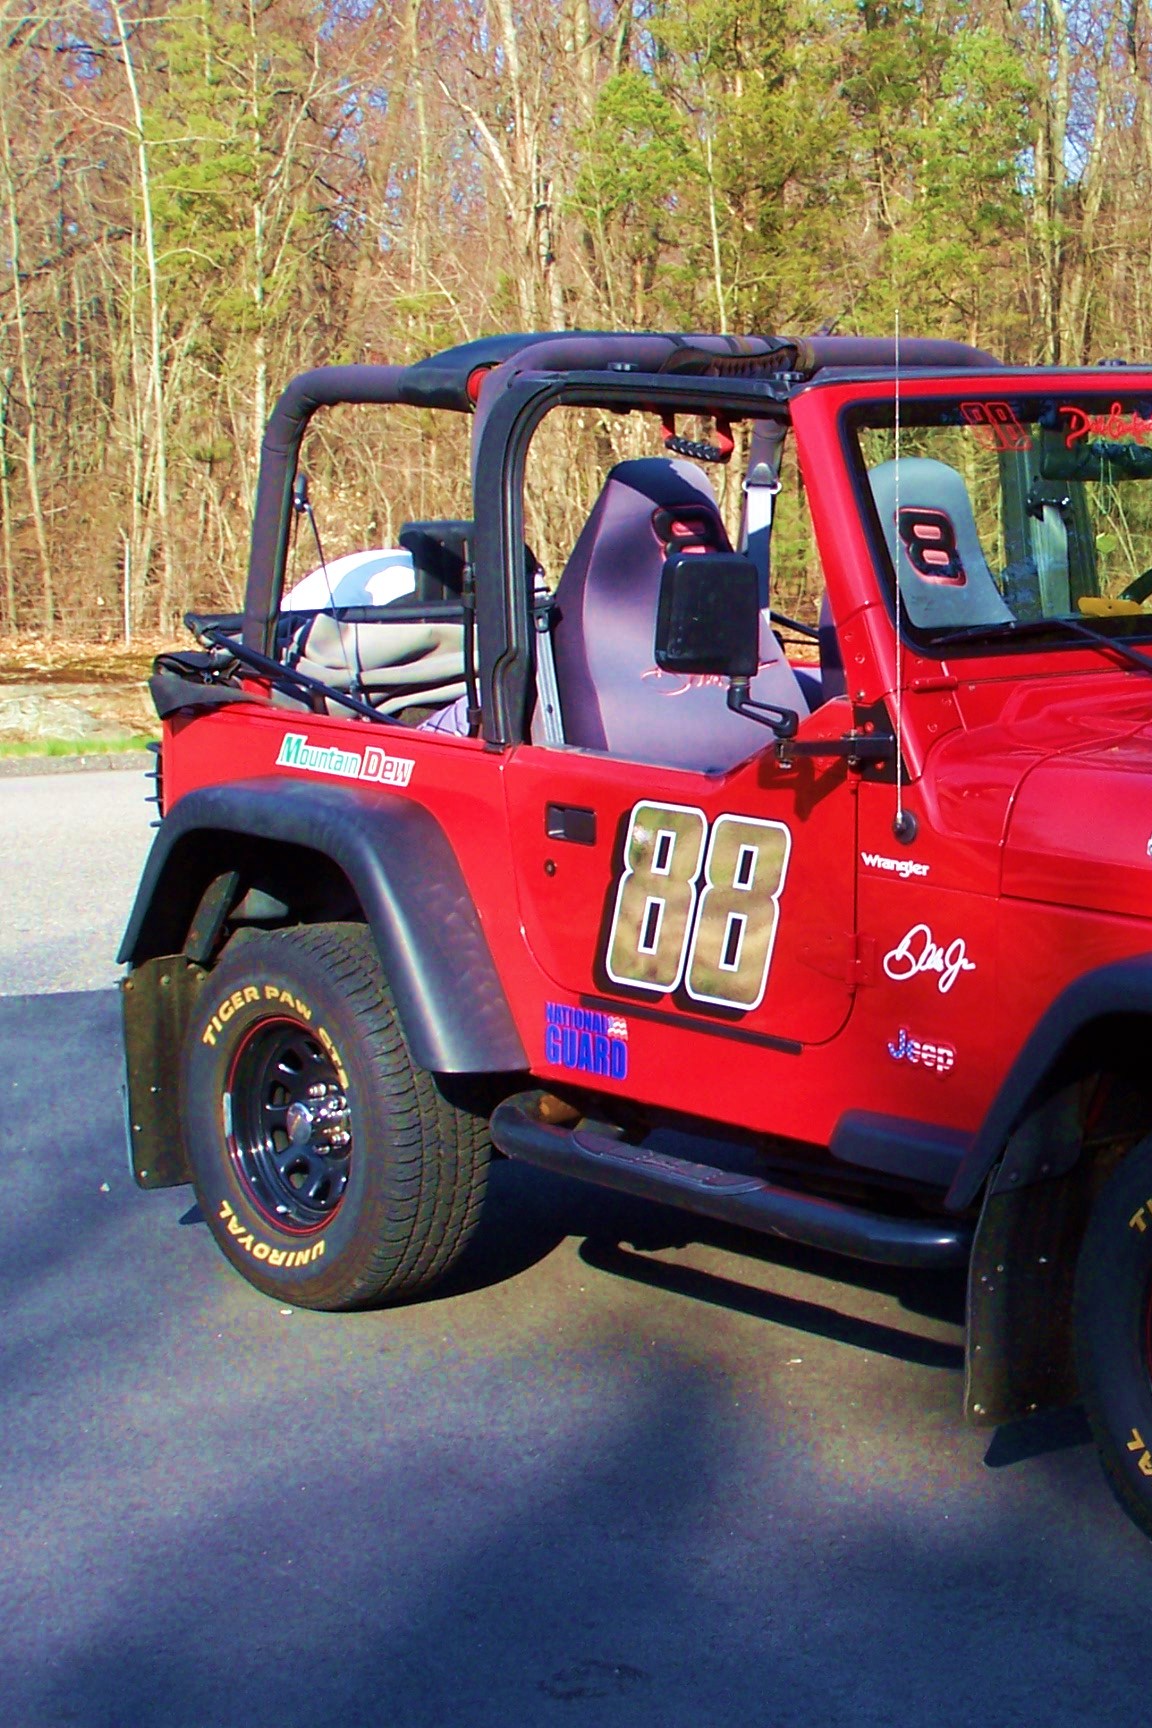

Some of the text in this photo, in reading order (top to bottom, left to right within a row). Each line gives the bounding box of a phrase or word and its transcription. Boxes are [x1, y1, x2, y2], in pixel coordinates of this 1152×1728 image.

[894, 506, 968, 588] 8
[277, 734, 415, 787] Mountain Dew
[861, 851, 930, 878] Wrangler
[605, 799, 792, 1011] 88
[202, 985, 260, 1047] TIGER
[264, 984, 312, 1021] PAW
[545, 1001, 610, 1036] NATIONAL
[545, 1023, 628, 1080] GUARD
[887, 1028, 955, 1073] Jeep
[218, 1199, 326, 1267] UNIROYAL
